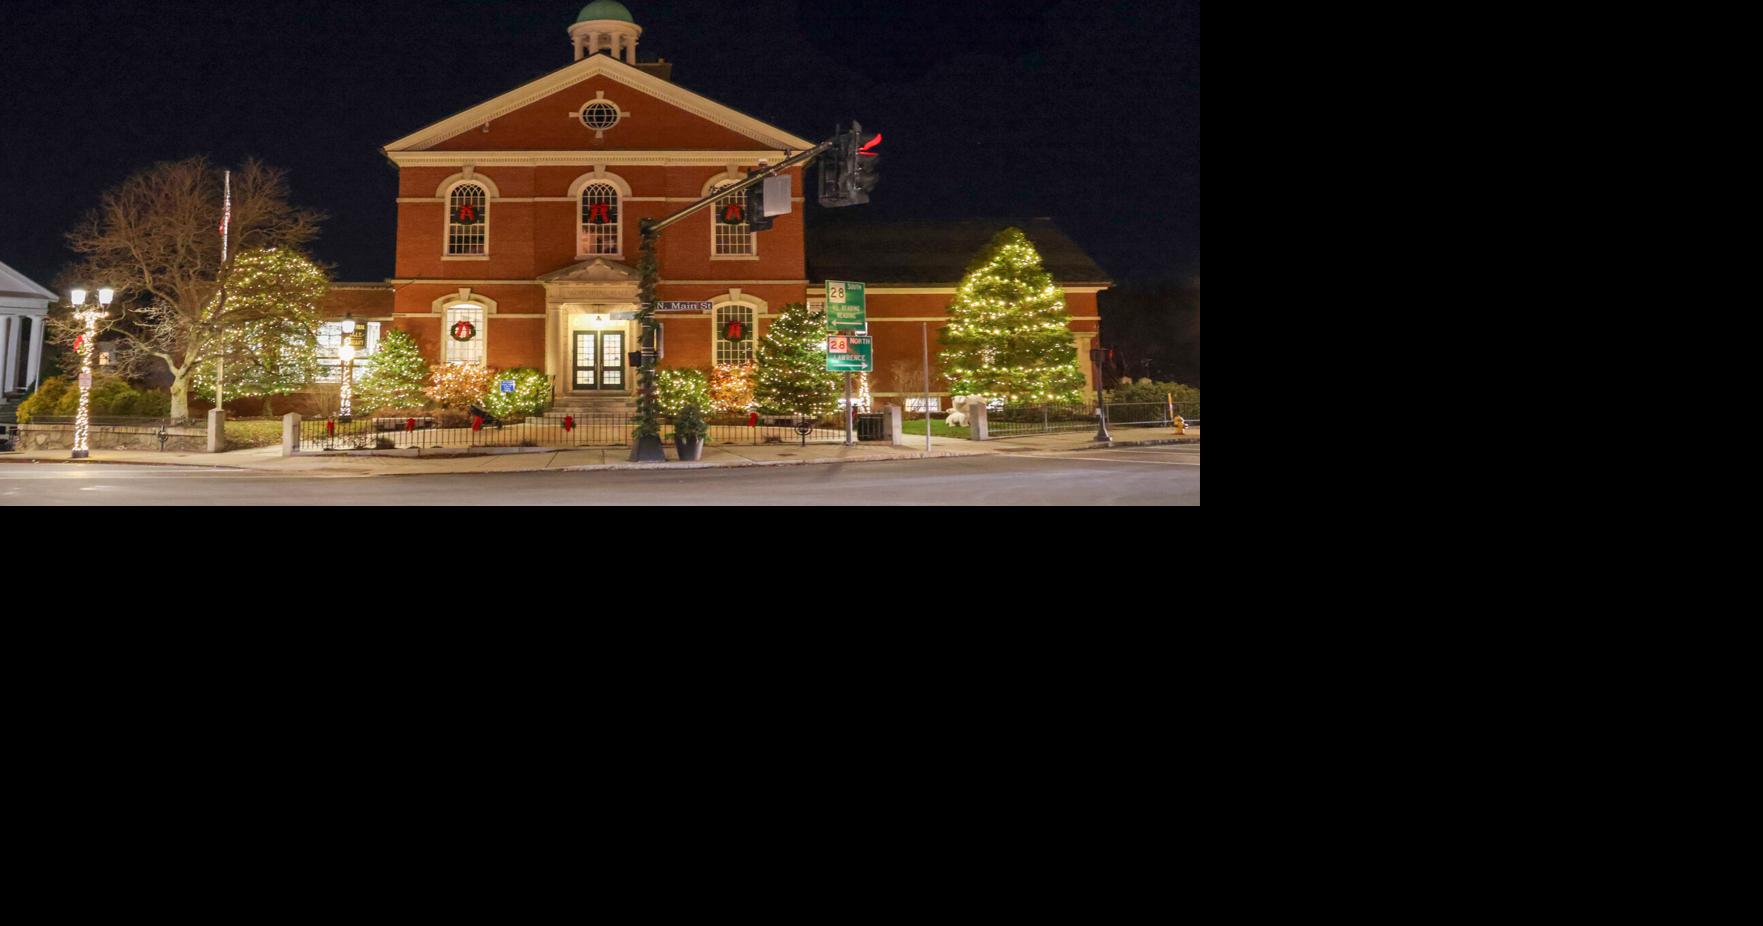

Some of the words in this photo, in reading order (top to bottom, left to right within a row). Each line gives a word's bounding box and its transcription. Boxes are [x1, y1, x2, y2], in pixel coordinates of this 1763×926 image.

[830, 287, 844, 298] 28
[656, 302, 667, 310] N.
[671, 302, 697, 310] Main
[700, 302, 711, 310] St
[830, 340, 846, 350] 28
